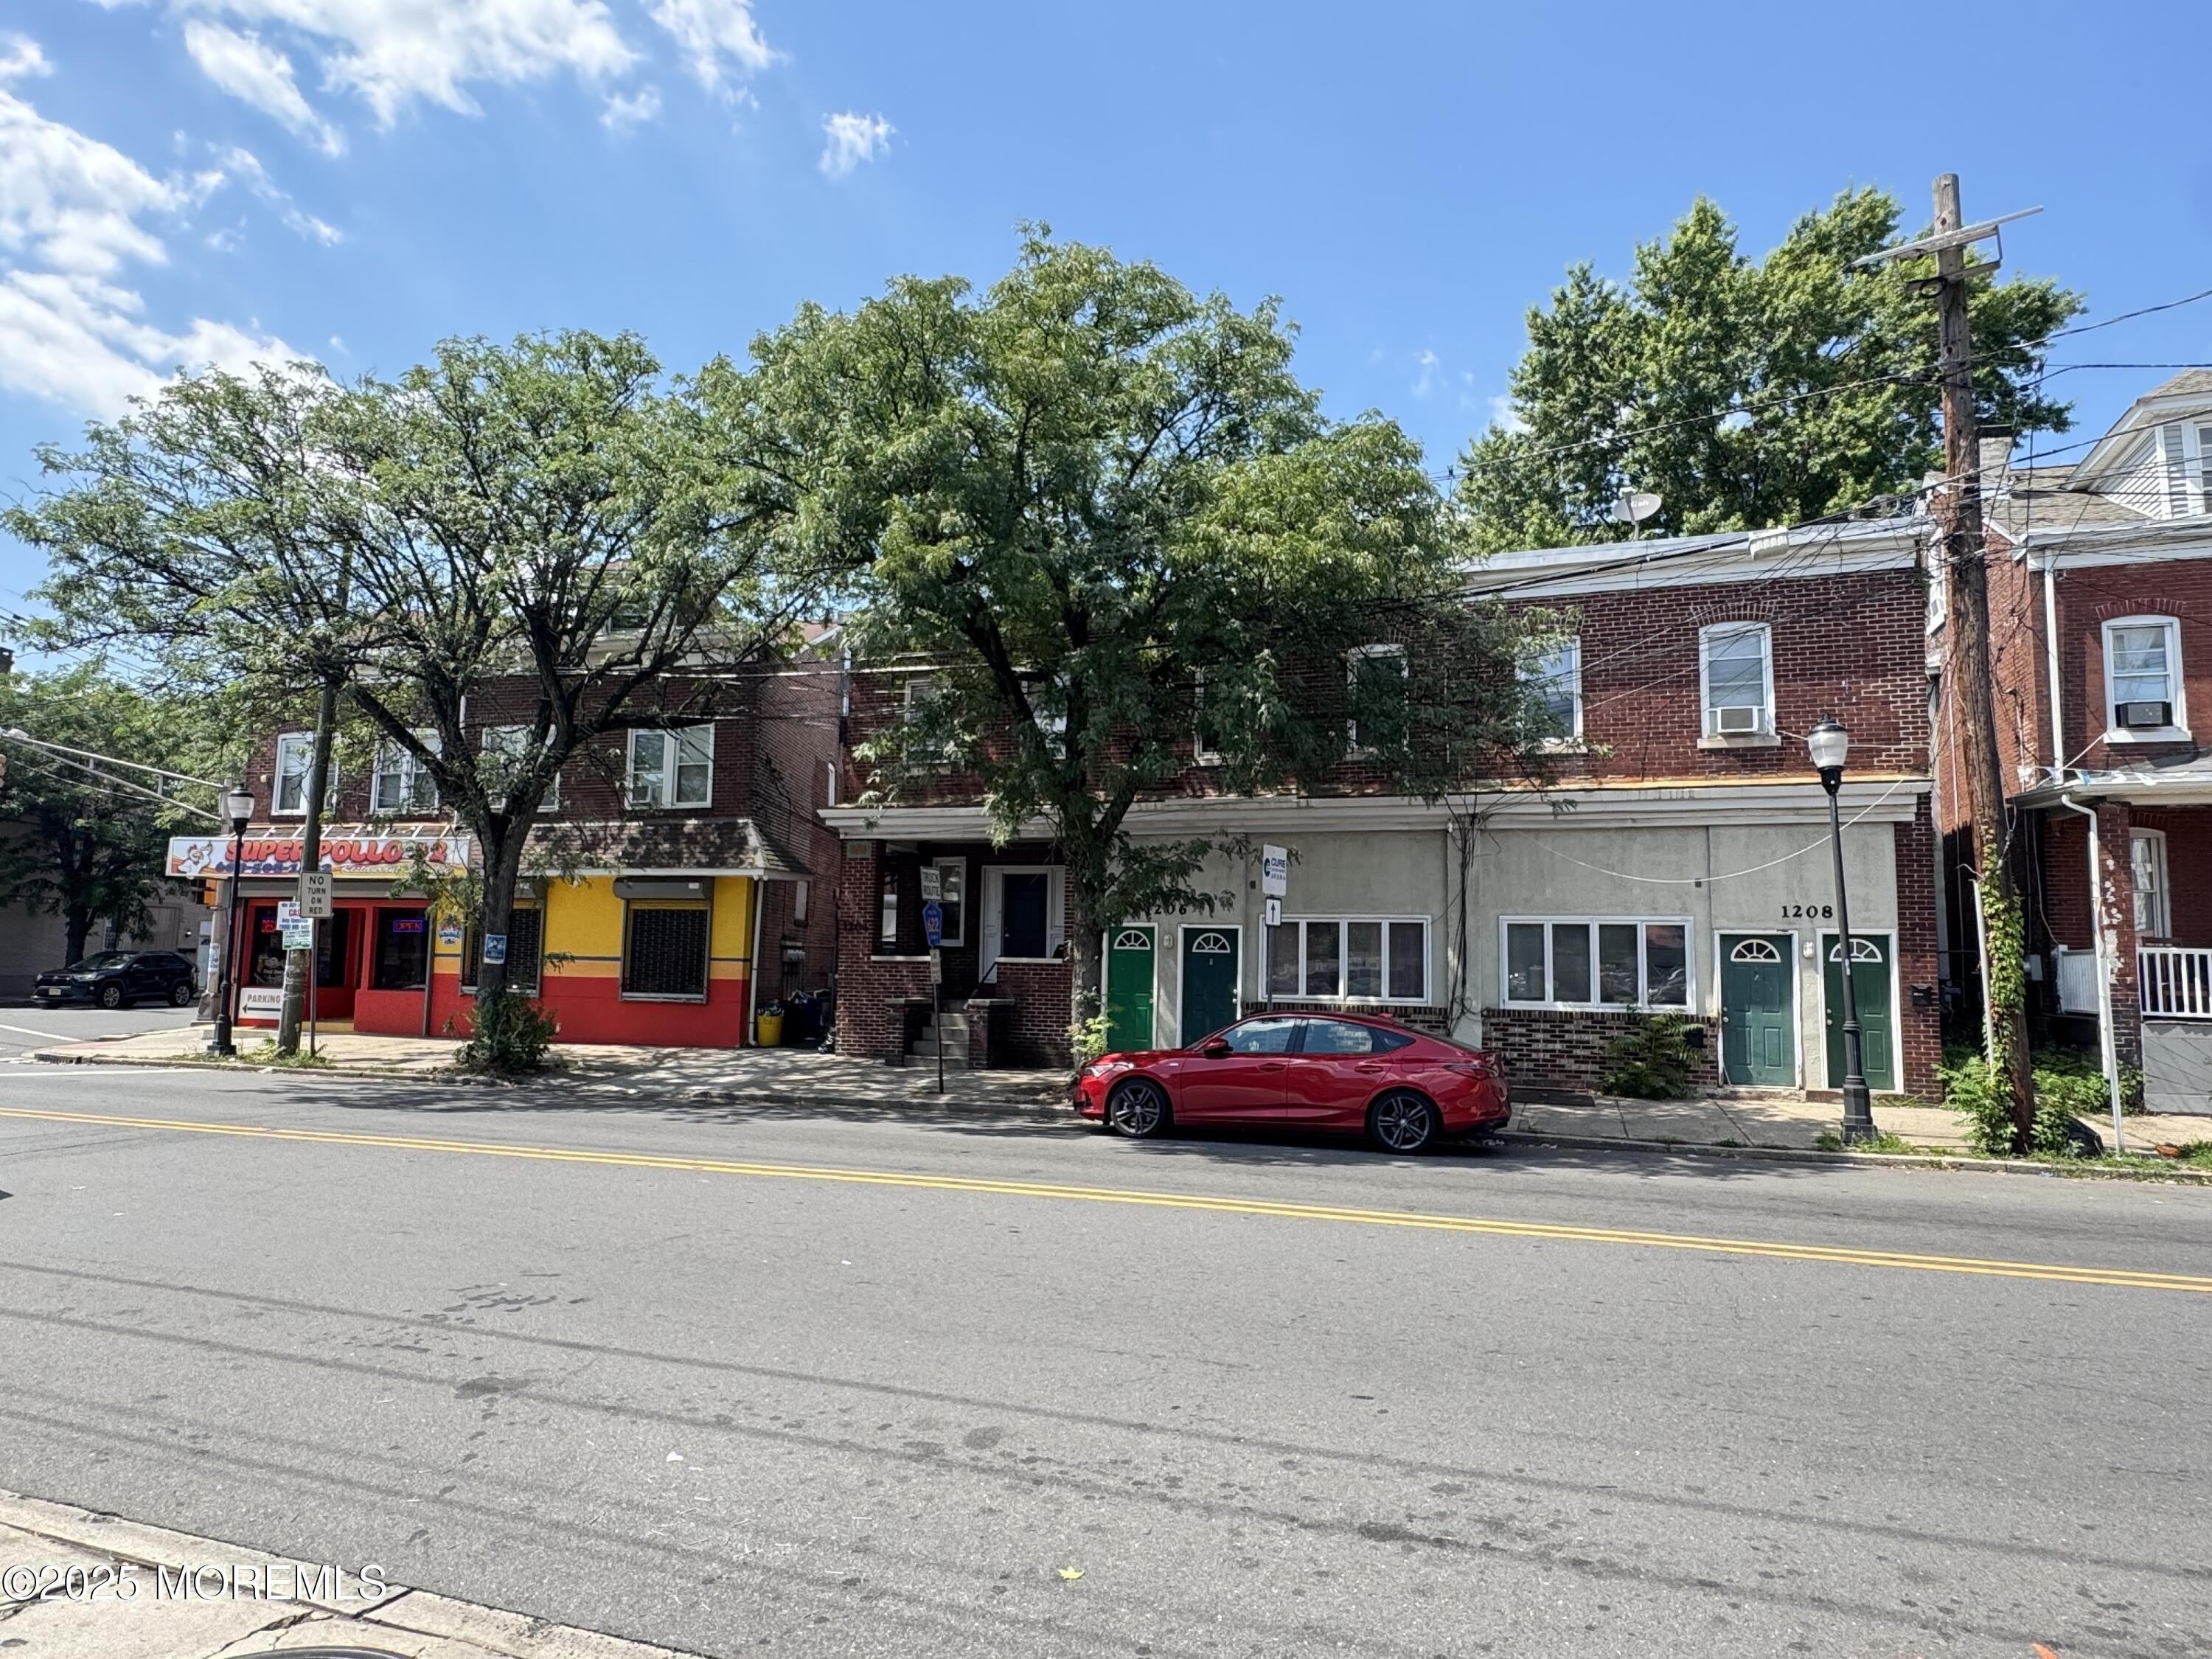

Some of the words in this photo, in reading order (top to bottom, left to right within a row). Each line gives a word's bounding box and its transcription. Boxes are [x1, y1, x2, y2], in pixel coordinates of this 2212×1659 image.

[318, 840, 404, 863] POLLO
[1271, 857, 1286, 869] CURE
[310, 876, 324, 885] NO
[922, 872, 939, 883] TRUCK
[923, 885, 940, 897] ROUTE
[310, 897, 322, 905] ON
[309, 906, 323, 914] RED
[1781, 905, 1834, 919] 1208
[247, 994, 281, 1004] PARKING
